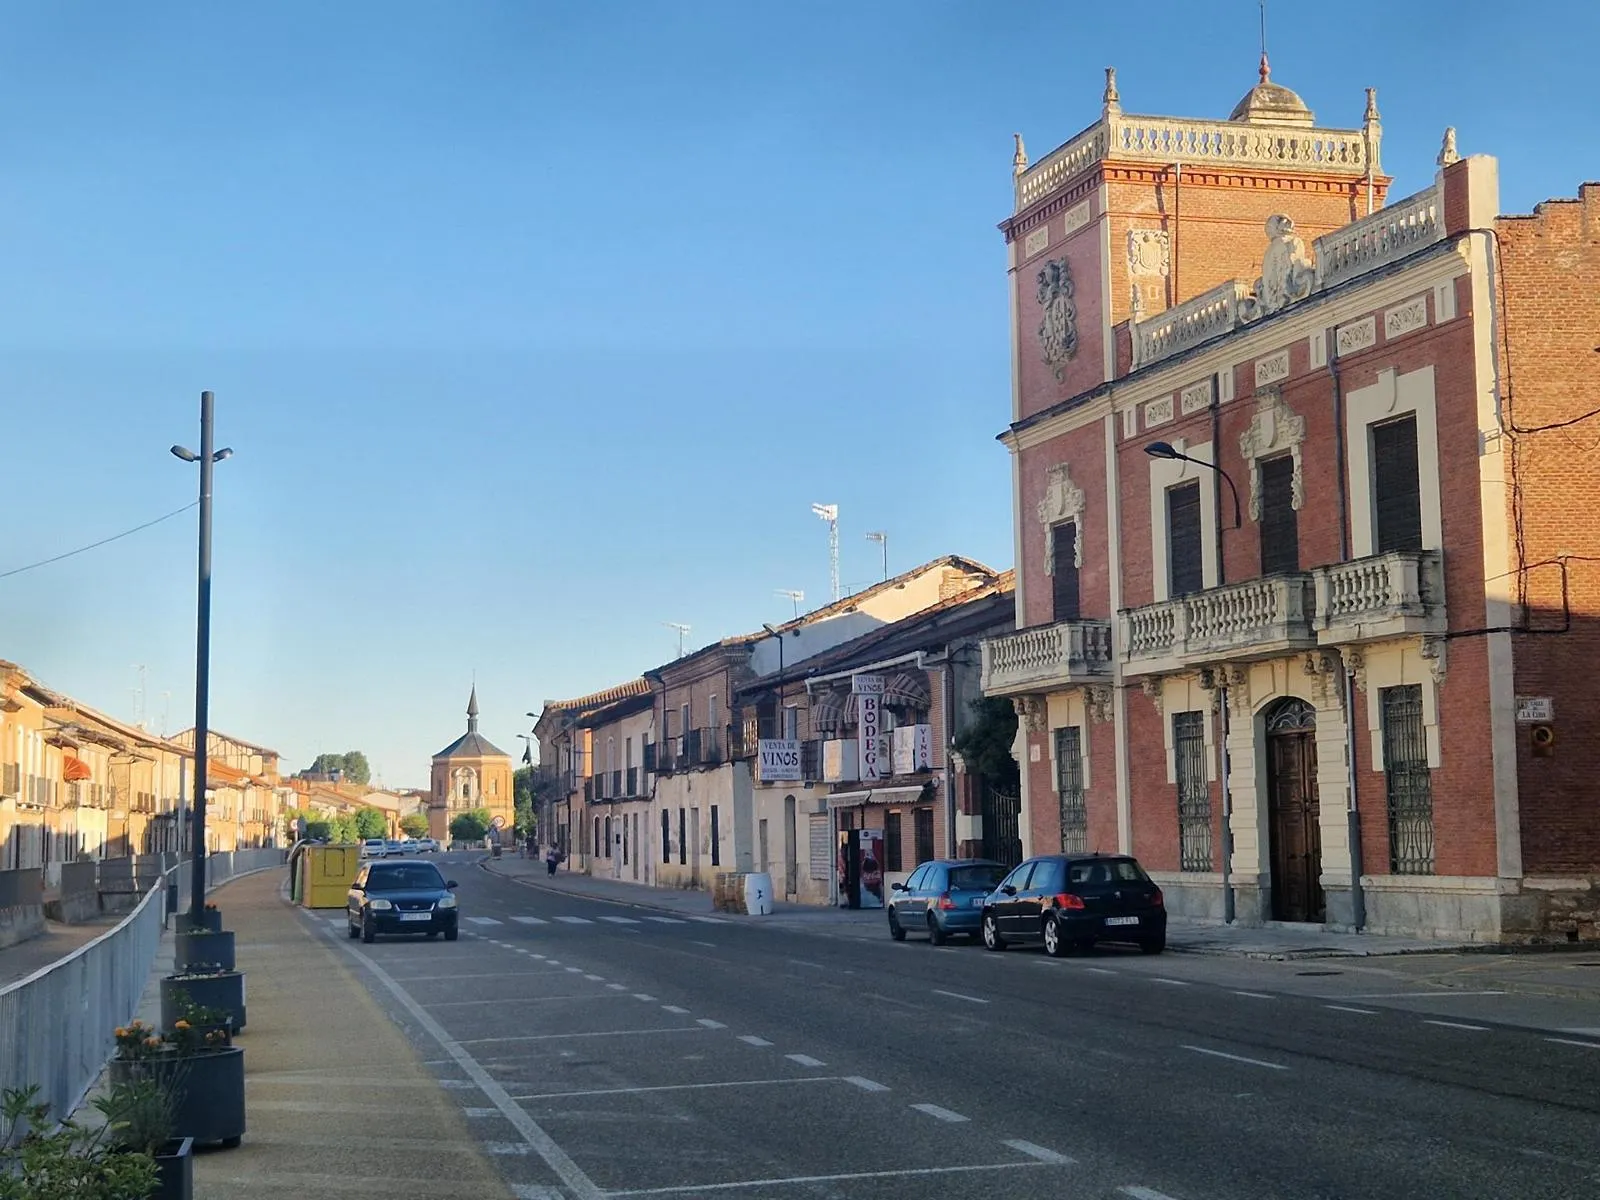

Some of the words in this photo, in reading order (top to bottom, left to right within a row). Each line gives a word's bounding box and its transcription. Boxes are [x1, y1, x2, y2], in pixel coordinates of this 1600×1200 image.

[858, 684, 882, 692] VINOS
[864, 698, 877, 778] BODEGA
[764, 742, 785, 750] VENTA
[762, 752, 798, 766] VINOS
